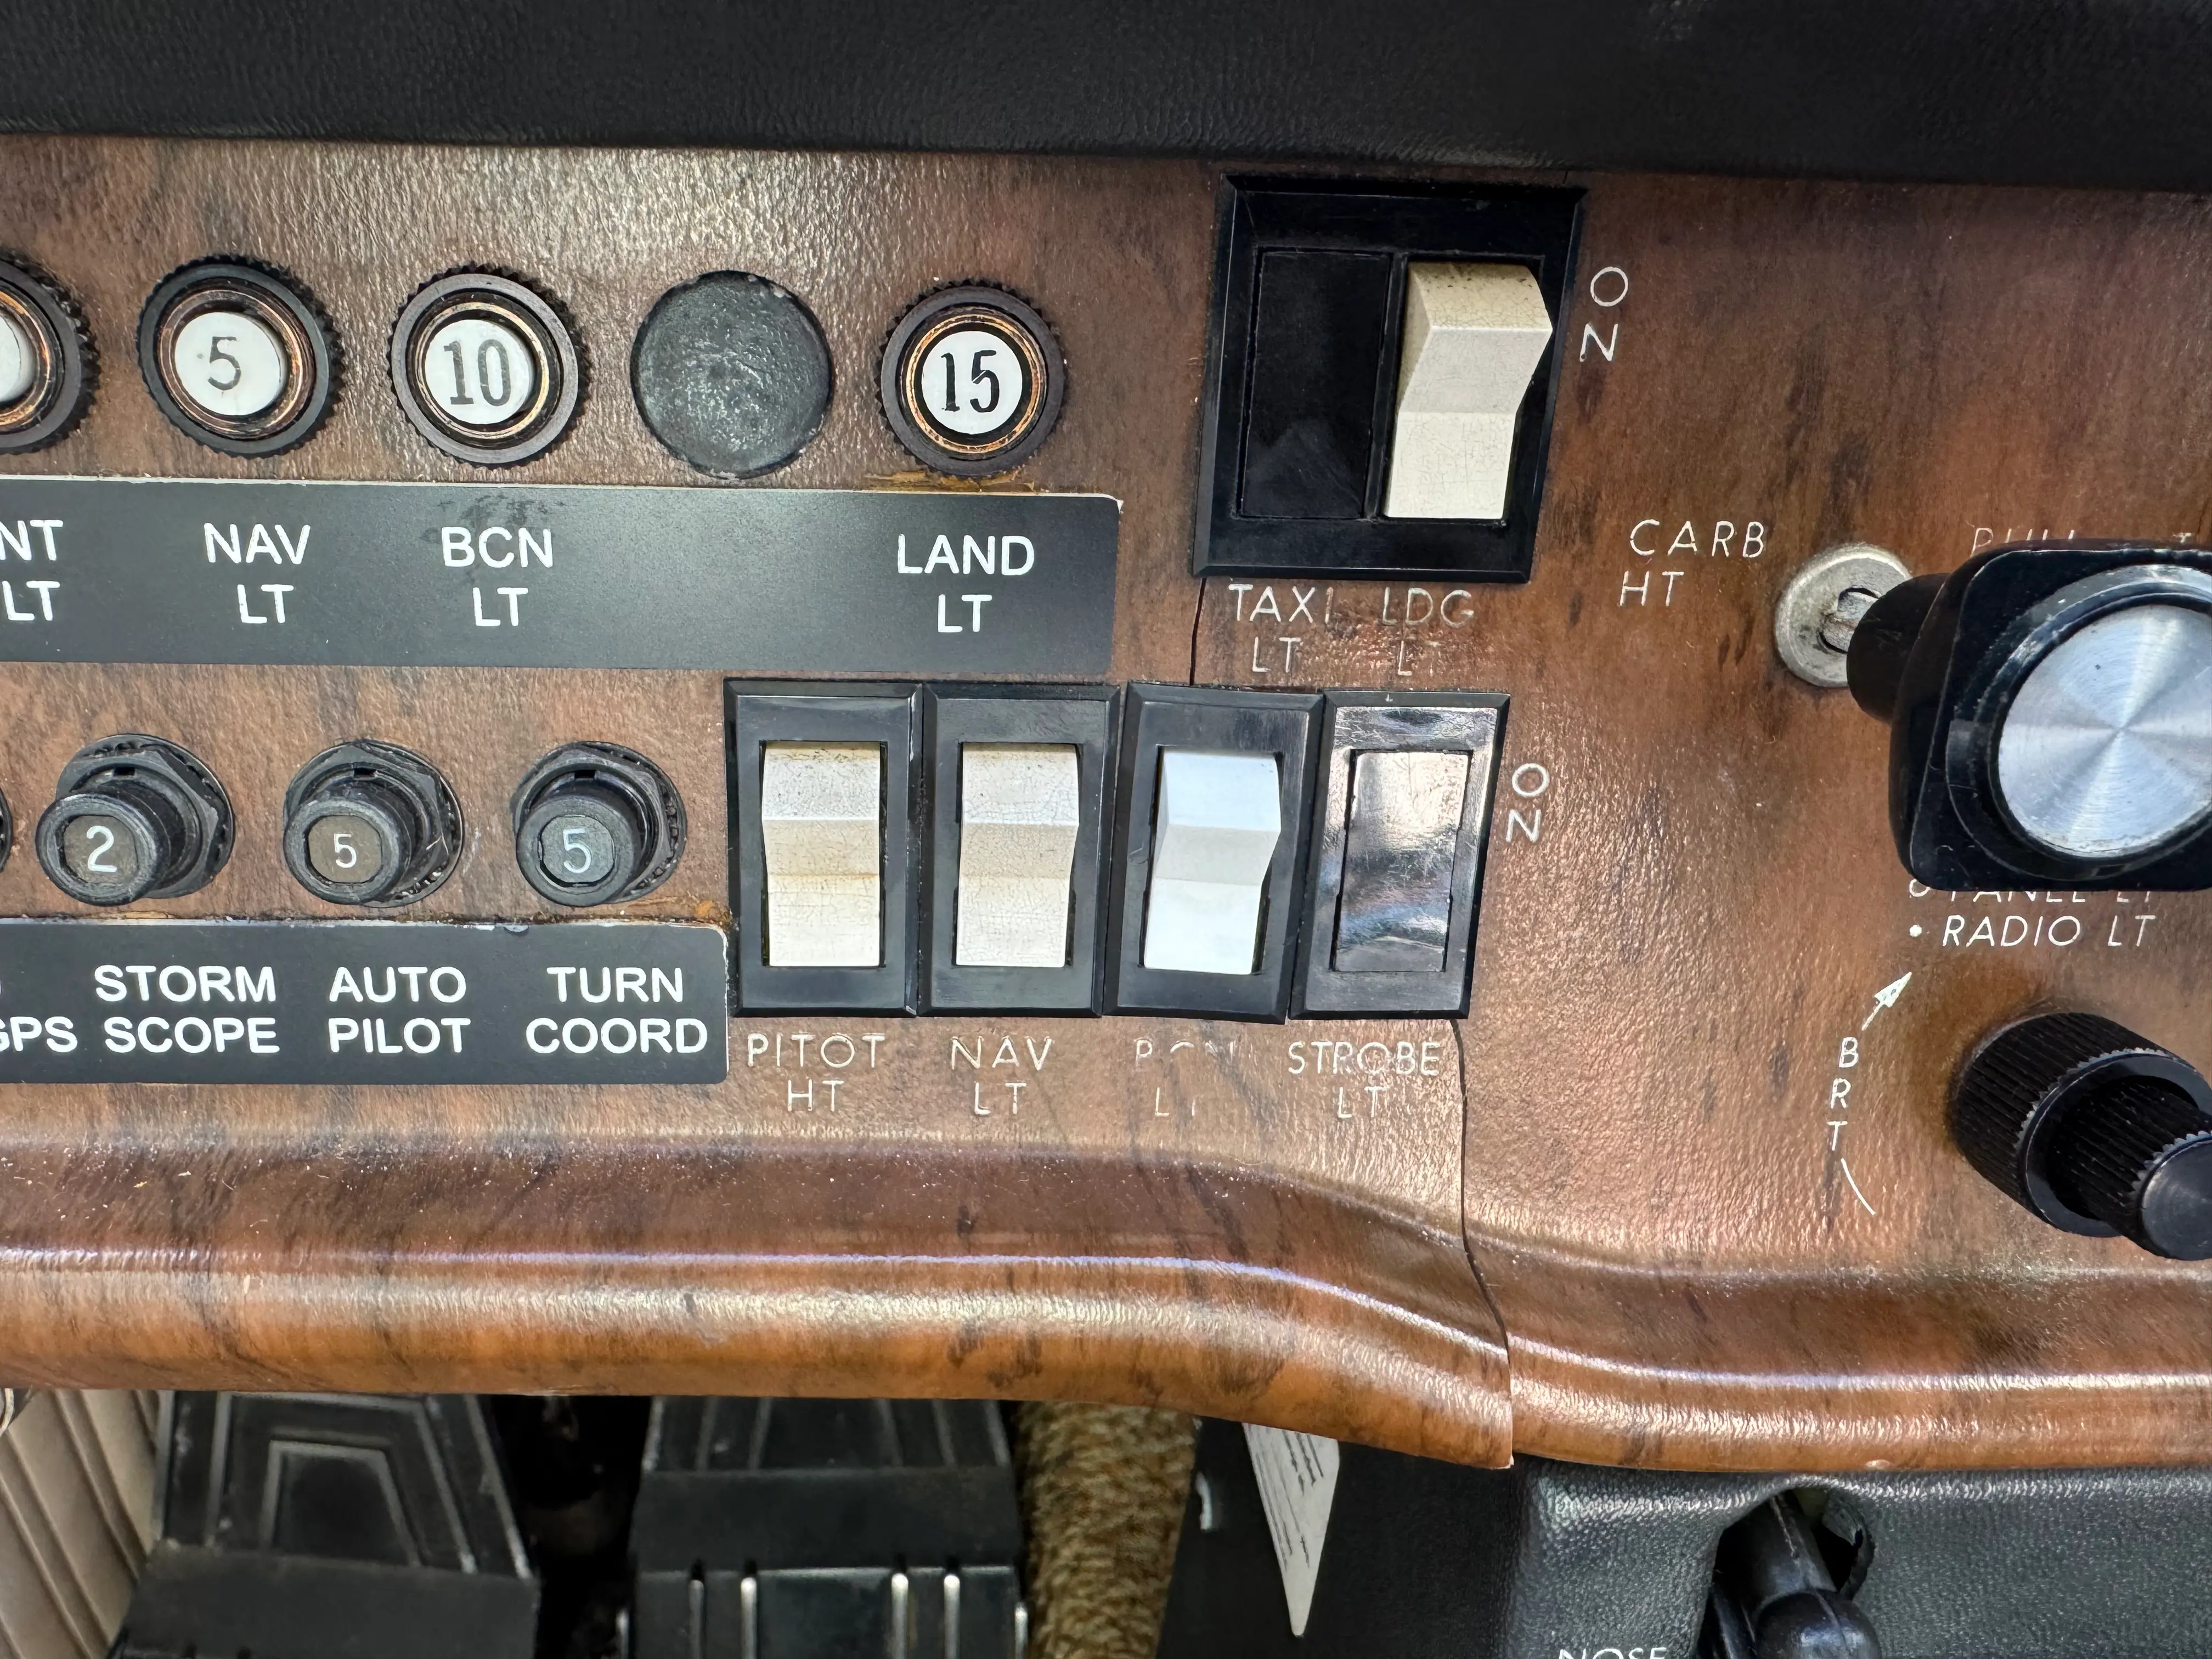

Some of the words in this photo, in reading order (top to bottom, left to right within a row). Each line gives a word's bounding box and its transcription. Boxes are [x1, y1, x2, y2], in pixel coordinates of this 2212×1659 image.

[1578, 266, 1629, 363] ON
[207, 336, 242, 391] 5
[443, 339, 513, 406] 10
[940, 349, 1000, 414] 15
[204, 523, 311, 565] NAV
[441, 526, 553, 568] BCN
[896, 533, 1036, 576] LAND
[1629, 518, 1765, 558] CARB
[2, 580, 60, 621] LT
[237, 584, 294, 624] LT
[472, 586, 529, 628] LT
[1228, 584, 1334, 623] TAXI
[1381, 586, 1475, 629] LDG
[1619, 570, 1685, 606] HT
[936, 594, 992, 634] LT
[1252, 637, 1301, 673] LT
[1505, 763, 1550, 843] ON
[86, 825, 117, 873] 2
[333, 833, 358, 868] 5
[562, 828, 592, 874] 5
[1942, 915, 2081, 946] RADIO
[2108, 915, 2156, 946] LT
[94, 964, 276, 1002] STORM
[329, 966, 467, 1003] AUTO
[546, 967, 684, 1003] TURN
[0, 1016, 78, 1053] PS
[104, 1016, 280, 1054] SCOPE
[328, 1017, 471, 1054] PILOT
[525, 1018, 708, 1054] COORD
[747, 1032, 886, 1069] PITOT
[951, 1035, 1056, 1070] NAV
[1289, 1041, 1441, 1076] STROBE
[788, 1079, 845, 1112] HT
[974, 1081, 1027, 1115] LT
[1338, 1086, 1389, 1118] LT
[1827, 1036, 1860, 1152] BRT
